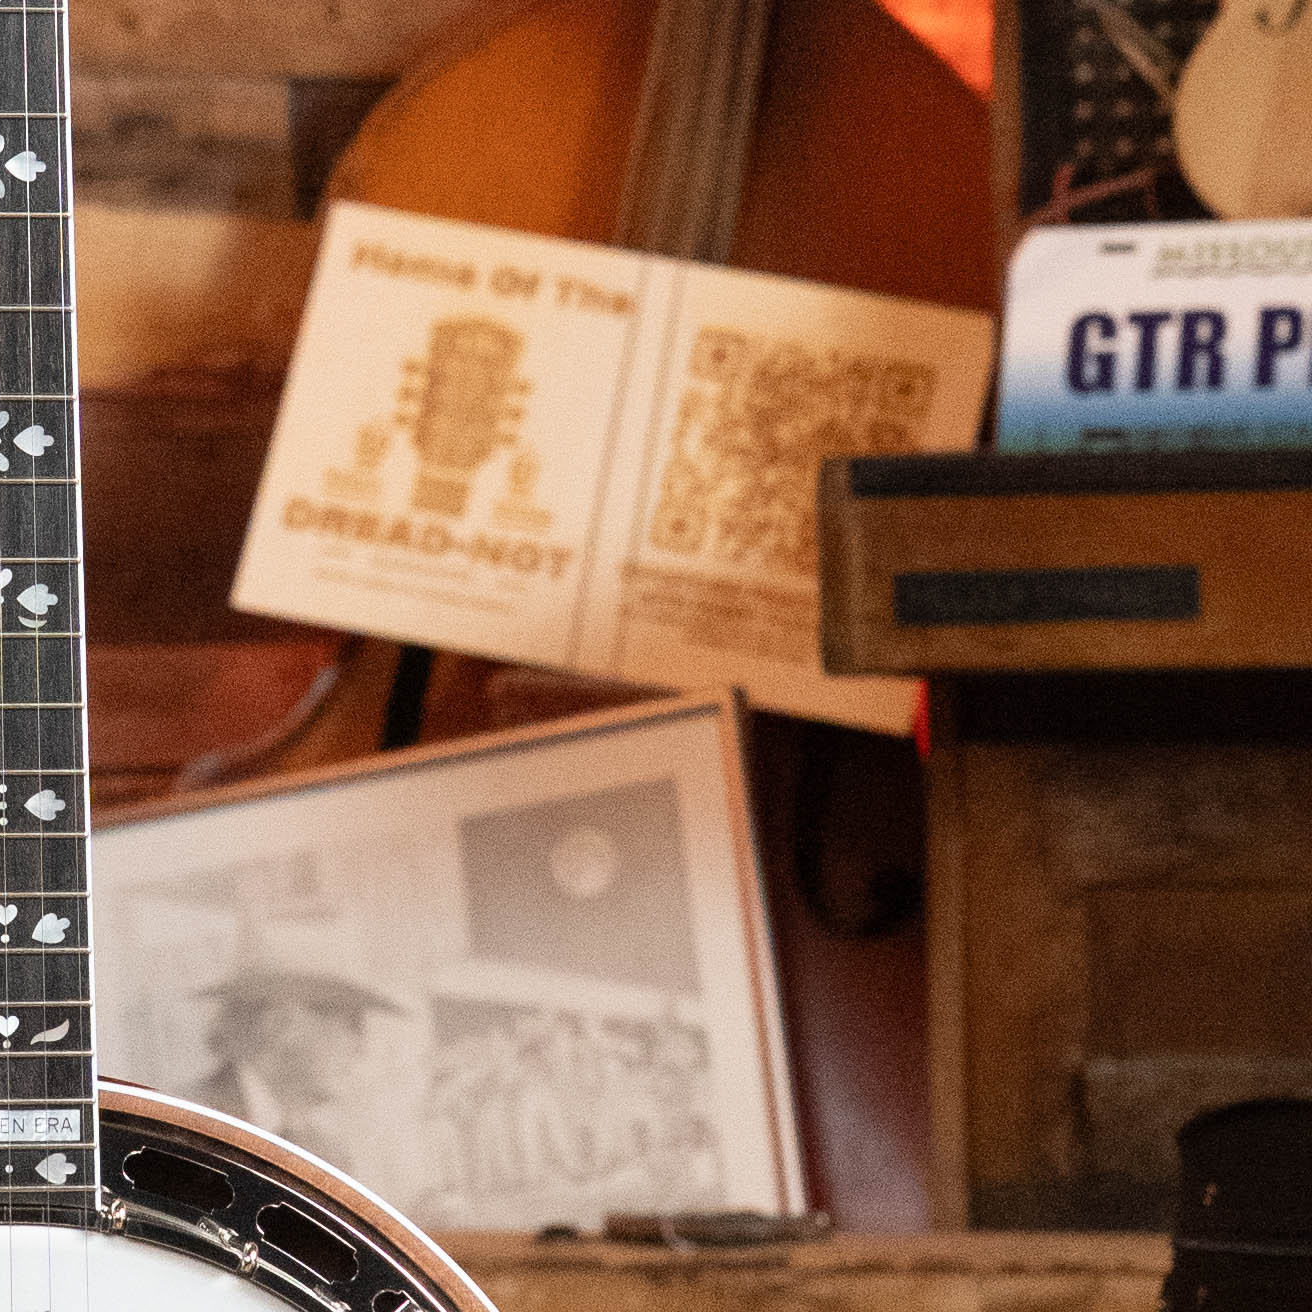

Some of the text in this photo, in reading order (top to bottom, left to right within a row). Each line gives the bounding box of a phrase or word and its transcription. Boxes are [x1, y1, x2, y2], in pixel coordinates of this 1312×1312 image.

[1067, 307, 1229, 394] GTR
[281, 496, 575, 580] DREAD-NOT
[34, 1116, 73, 1135] ERA
